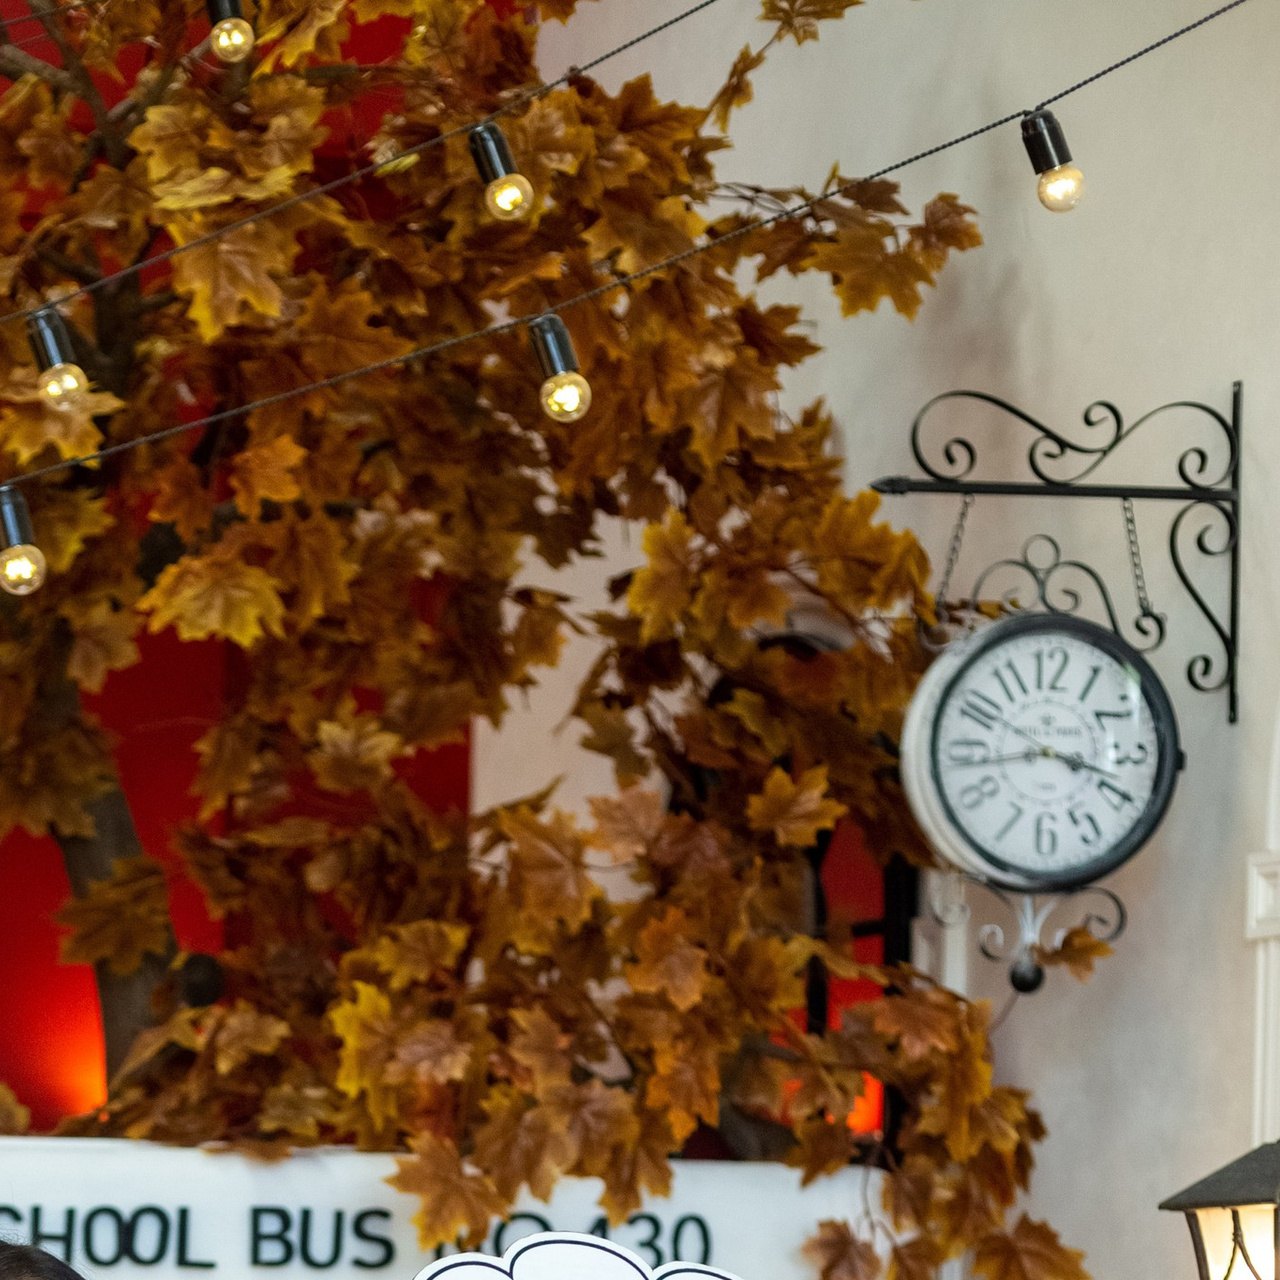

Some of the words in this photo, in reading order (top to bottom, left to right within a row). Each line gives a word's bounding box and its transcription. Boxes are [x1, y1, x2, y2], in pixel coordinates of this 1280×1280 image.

[991, 660, 1029, 702] 11
[1029, 647, 1070, 691] 12
[1078, 664, 1102, 701] 1
[949, 737, 990, 765] 9
[1111, 742, 1148, 765] 3
[959, 775, 1000, 809] 8
[1097, 779, 1134, 811] 4
[994, 801, 1024, 842] 7
[1034, 811, 1060, 855] 6
[1068, 808, 1103, 844] 5
[250, 1207, 396, 1268] BUS
